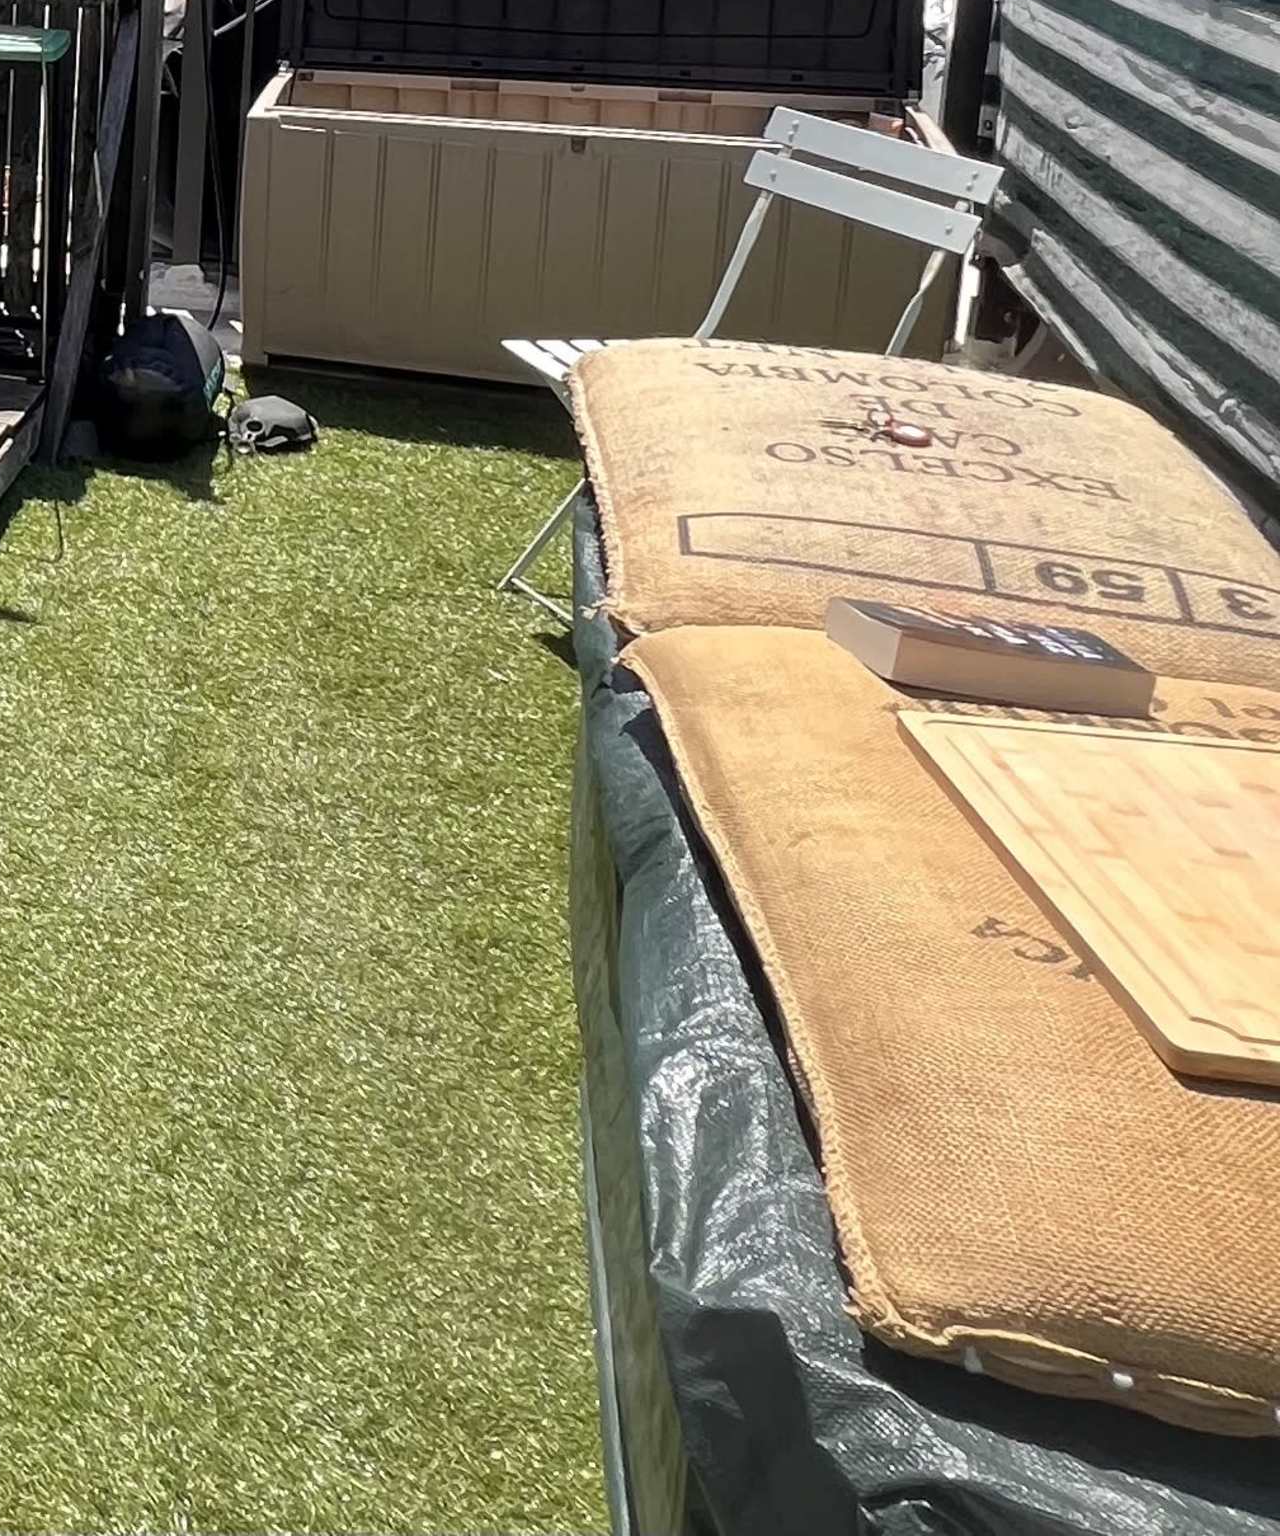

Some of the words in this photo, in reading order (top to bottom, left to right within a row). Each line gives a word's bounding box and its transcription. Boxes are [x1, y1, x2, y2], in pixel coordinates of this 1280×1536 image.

[693, 363, 1083, 418] COLOMBIA
[849, 393, 959, 422] DE
[765, 442, 1133, 503] EXCELSO
[1034, 560, 1146, 603] 59
